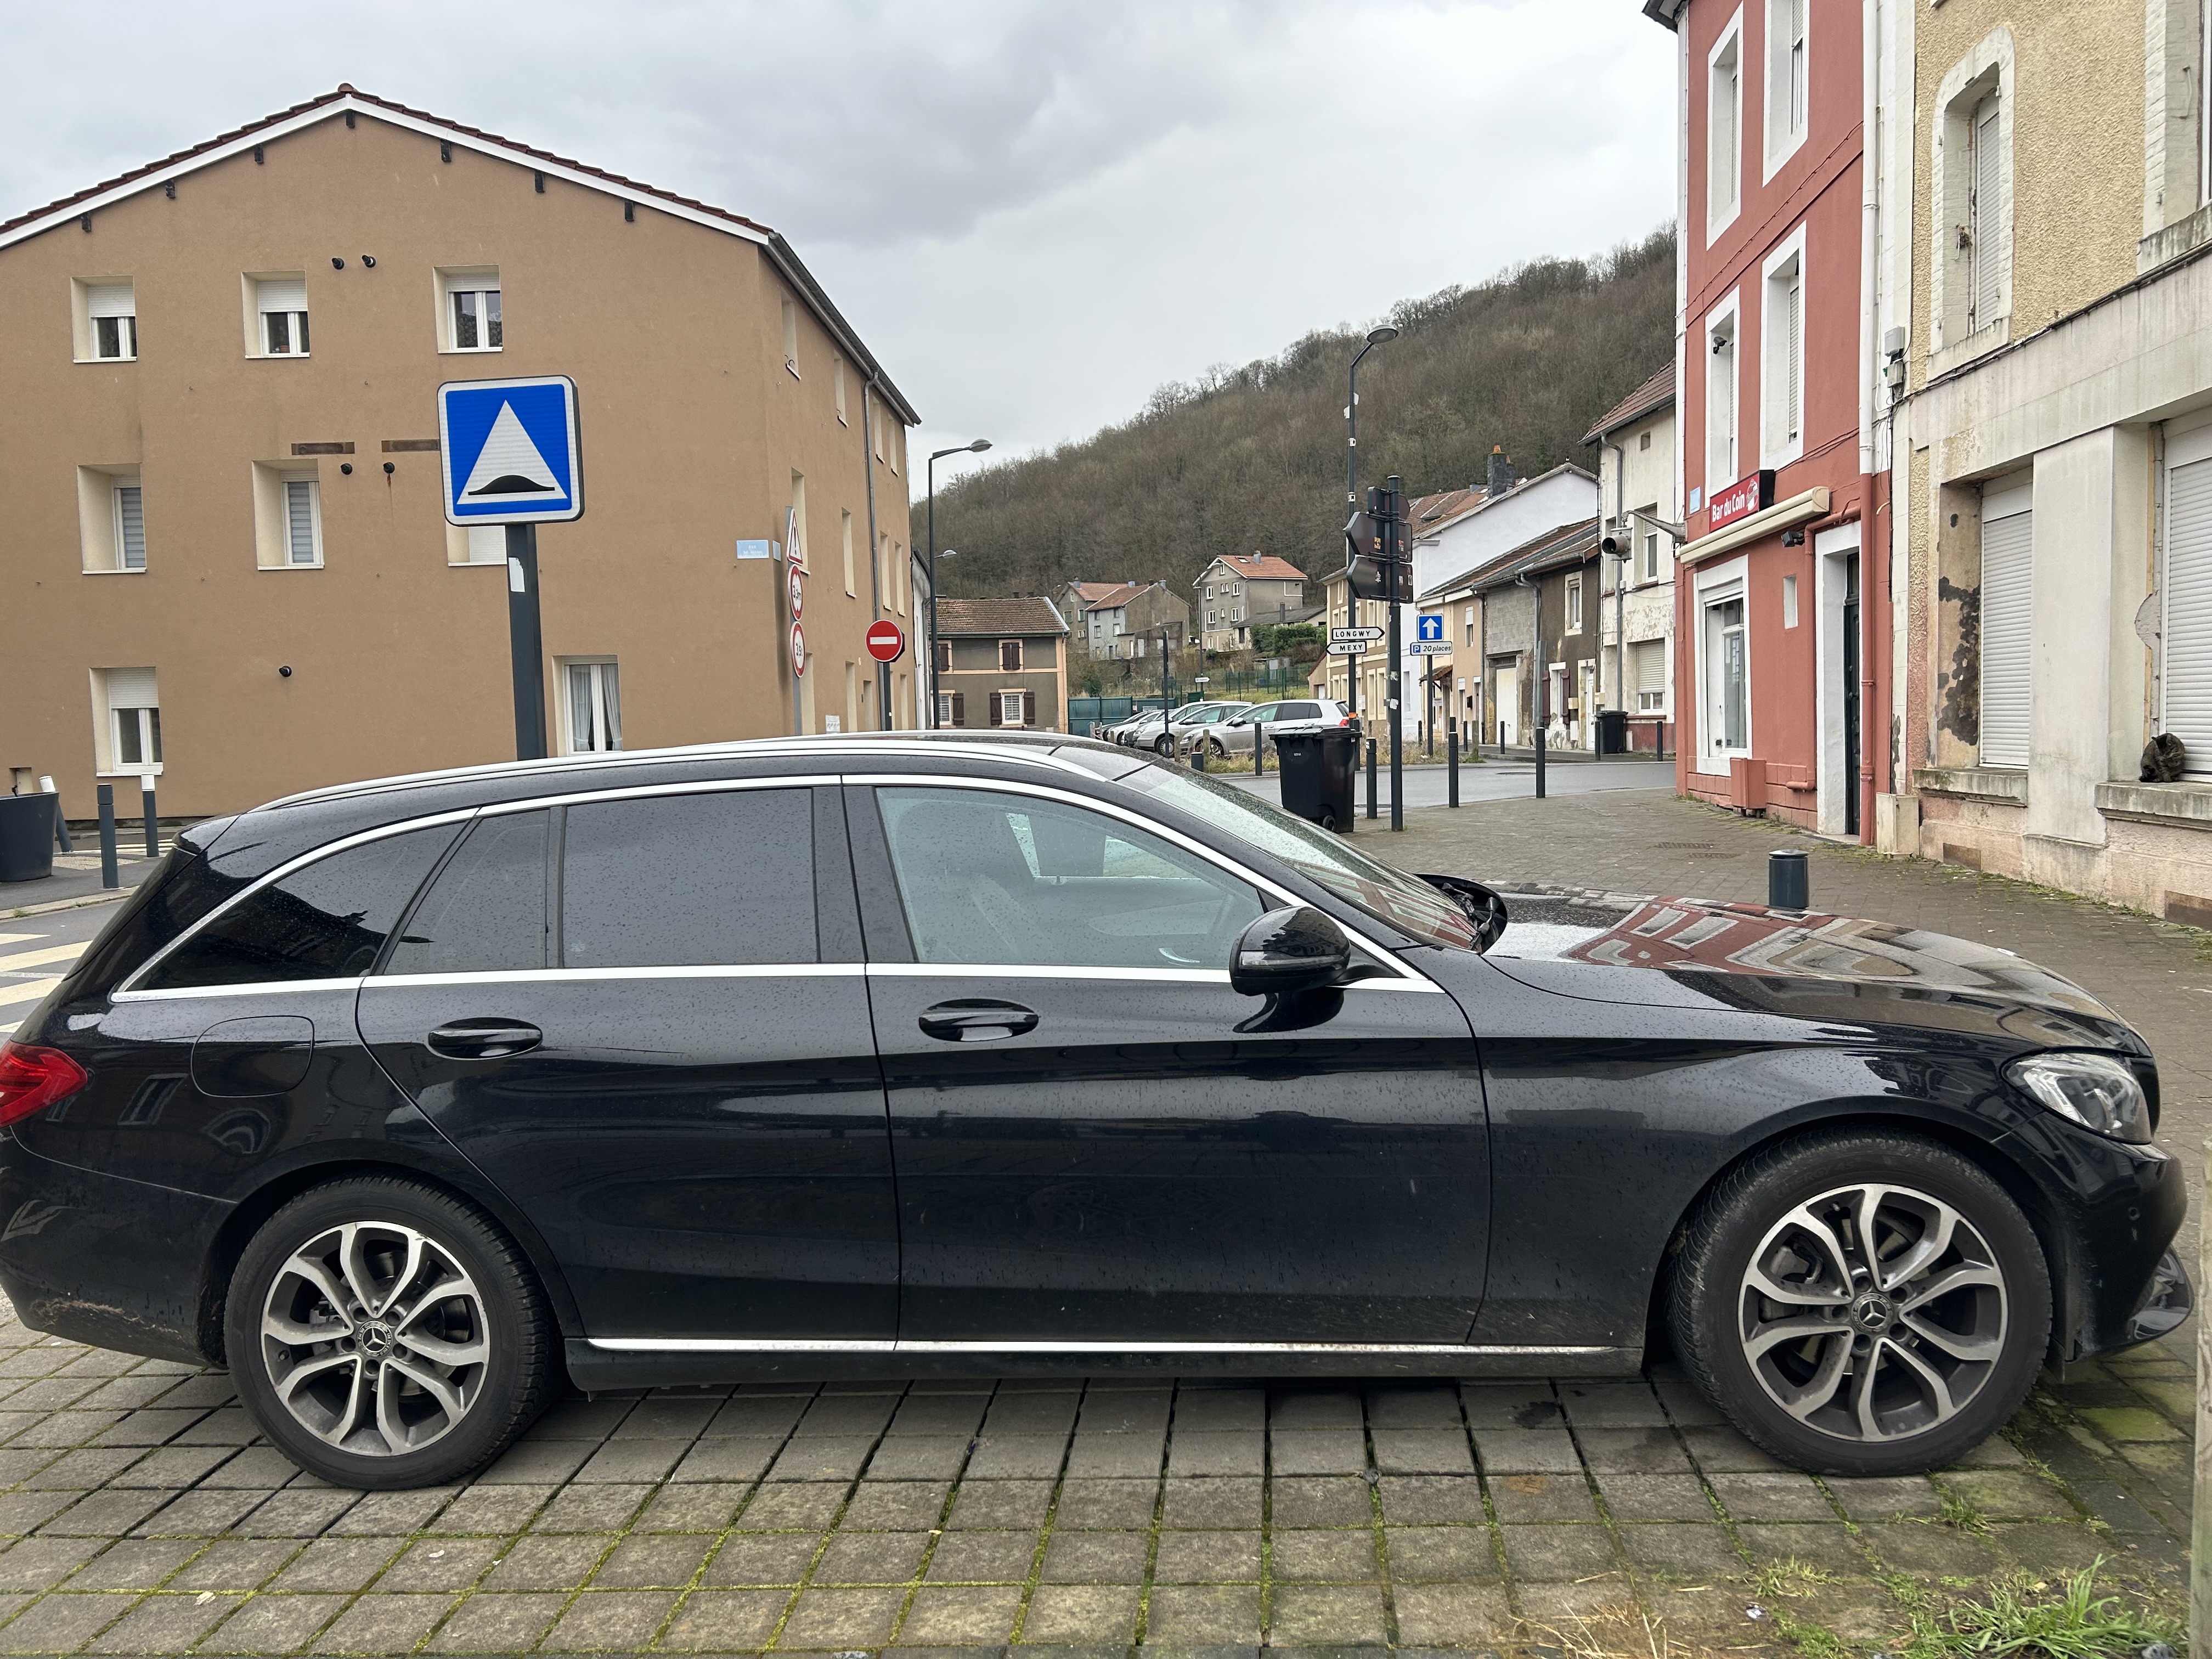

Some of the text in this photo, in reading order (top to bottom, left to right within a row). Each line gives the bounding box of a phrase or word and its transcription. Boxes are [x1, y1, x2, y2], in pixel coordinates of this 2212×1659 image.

[1712, 504, 1723, 522] Bar
[1724, 498, 1731, 517] du
[1732, 490, 1745, 512] Coin
